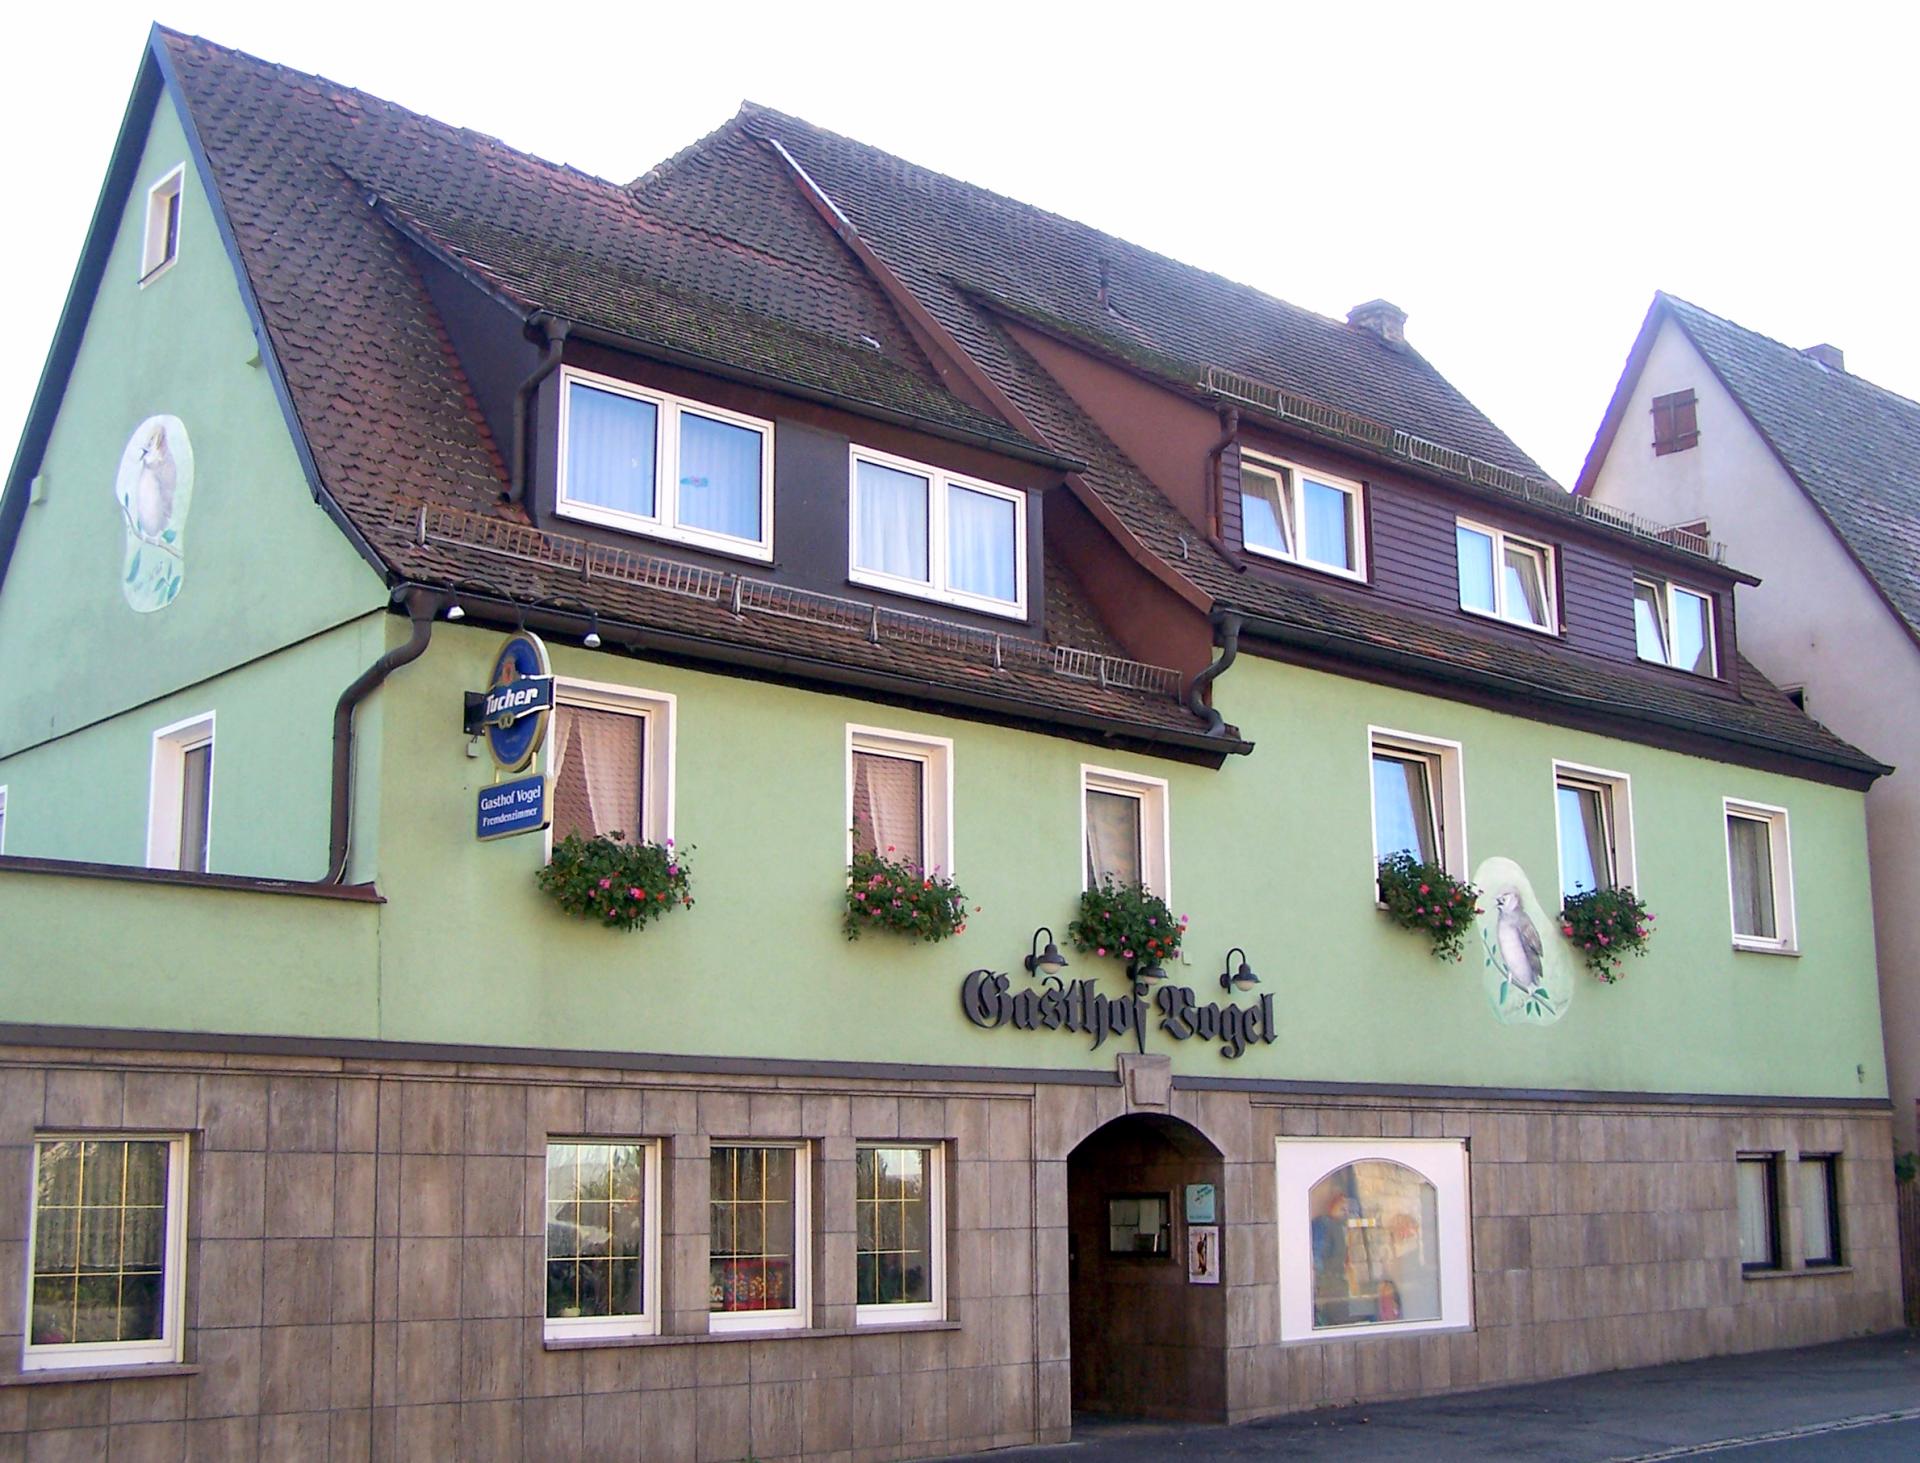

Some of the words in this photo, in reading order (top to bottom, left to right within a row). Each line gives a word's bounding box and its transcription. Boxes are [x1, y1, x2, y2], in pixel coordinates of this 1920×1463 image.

[486, 688, 538, 715] Tucher
[481, 790, 516, 810] Gasthof
[517, 785, 541, 804] Vogel
[482, 807, 538, 827] Fremdenzimmer
[962, 969, 1150, 1054] Gasthof
[1155, 985, 1277, 1059] Vogel
